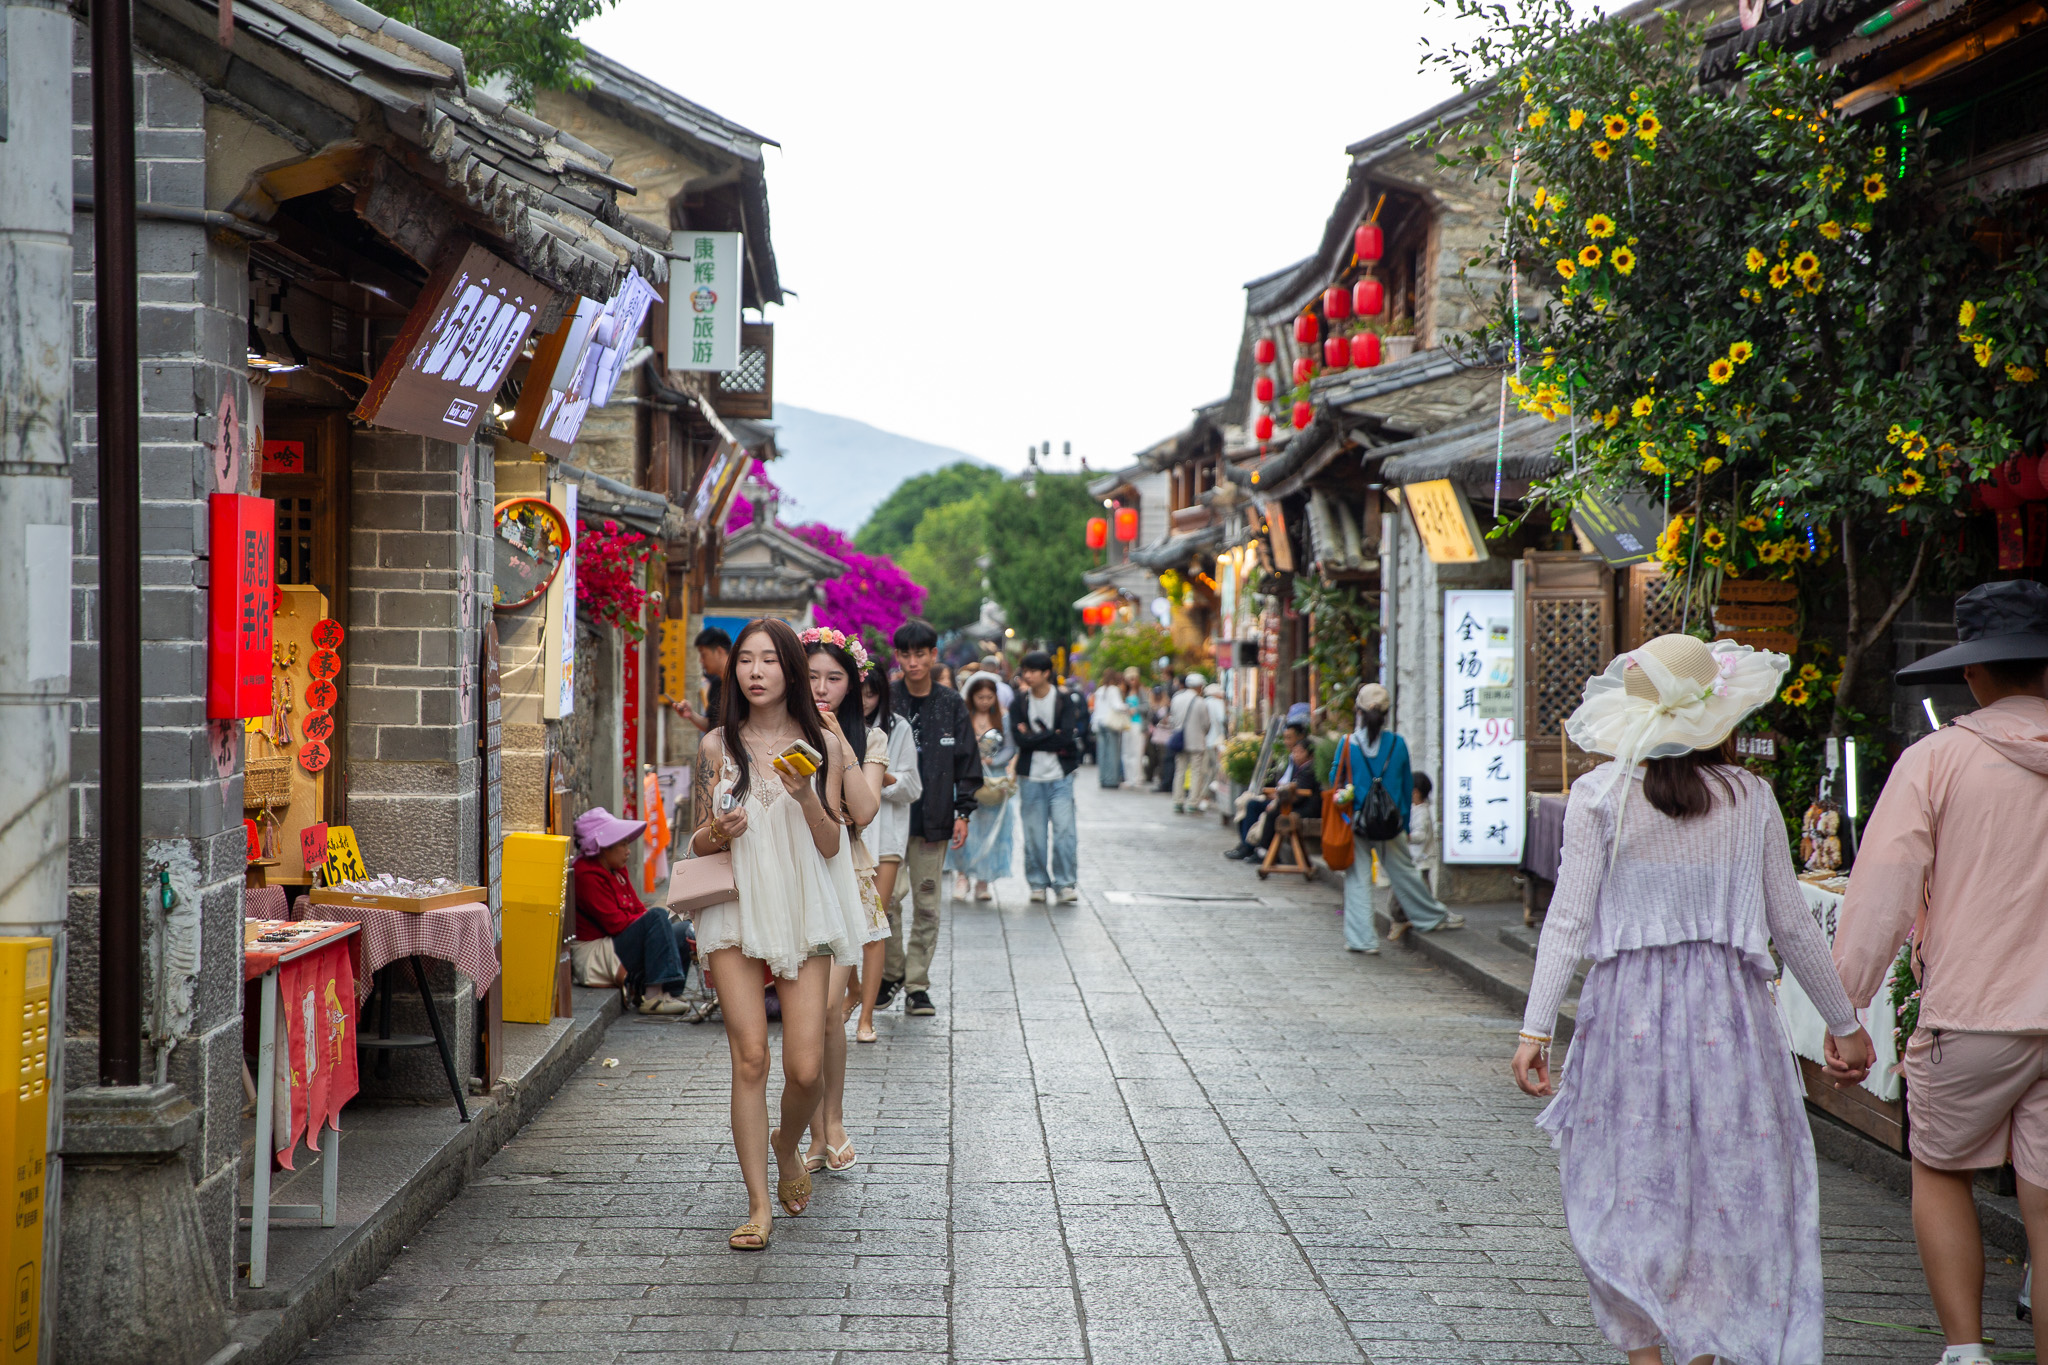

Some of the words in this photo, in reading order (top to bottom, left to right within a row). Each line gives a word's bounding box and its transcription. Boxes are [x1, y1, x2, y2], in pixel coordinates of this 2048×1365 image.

[693, 237, 715, 283] 康辉
[692, 315, 715, 363] 旅游
[243, 529, 270, 588] 原创
[242, 591, 269, 651] 手作
[1456, 611, 1484, 751] 全场耳环
[1486, 756, 1511, 845] 元一对
